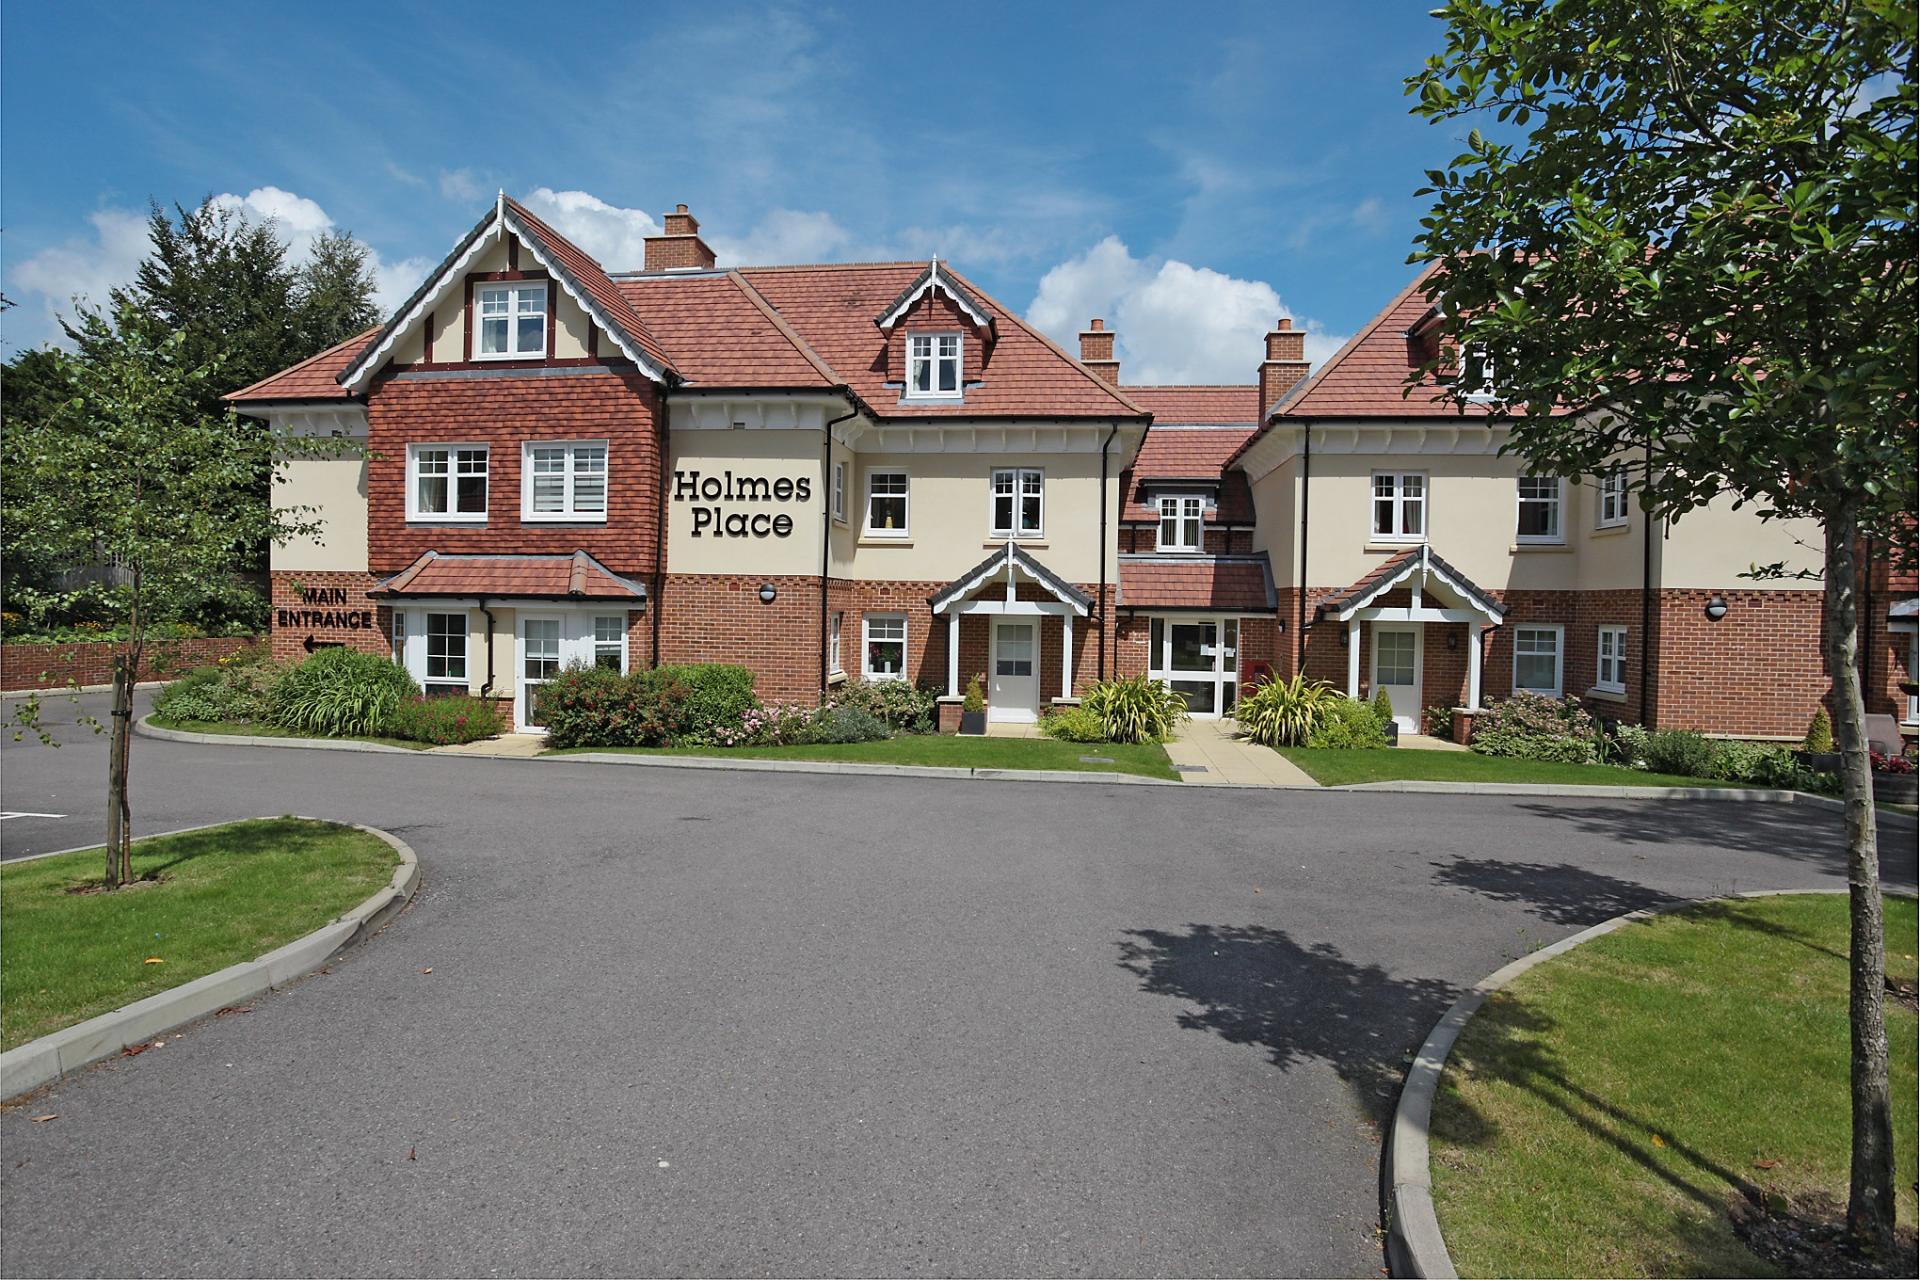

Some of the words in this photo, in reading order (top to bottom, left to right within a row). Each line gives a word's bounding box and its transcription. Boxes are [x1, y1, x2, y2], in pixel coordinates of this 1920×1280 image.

[674, 471, 811, 502] Holmes
[691, 507, 793, 538] Place
[303, 588, 347, 605] MAIN
[278, 610, 372, 629] ENTRANCE
